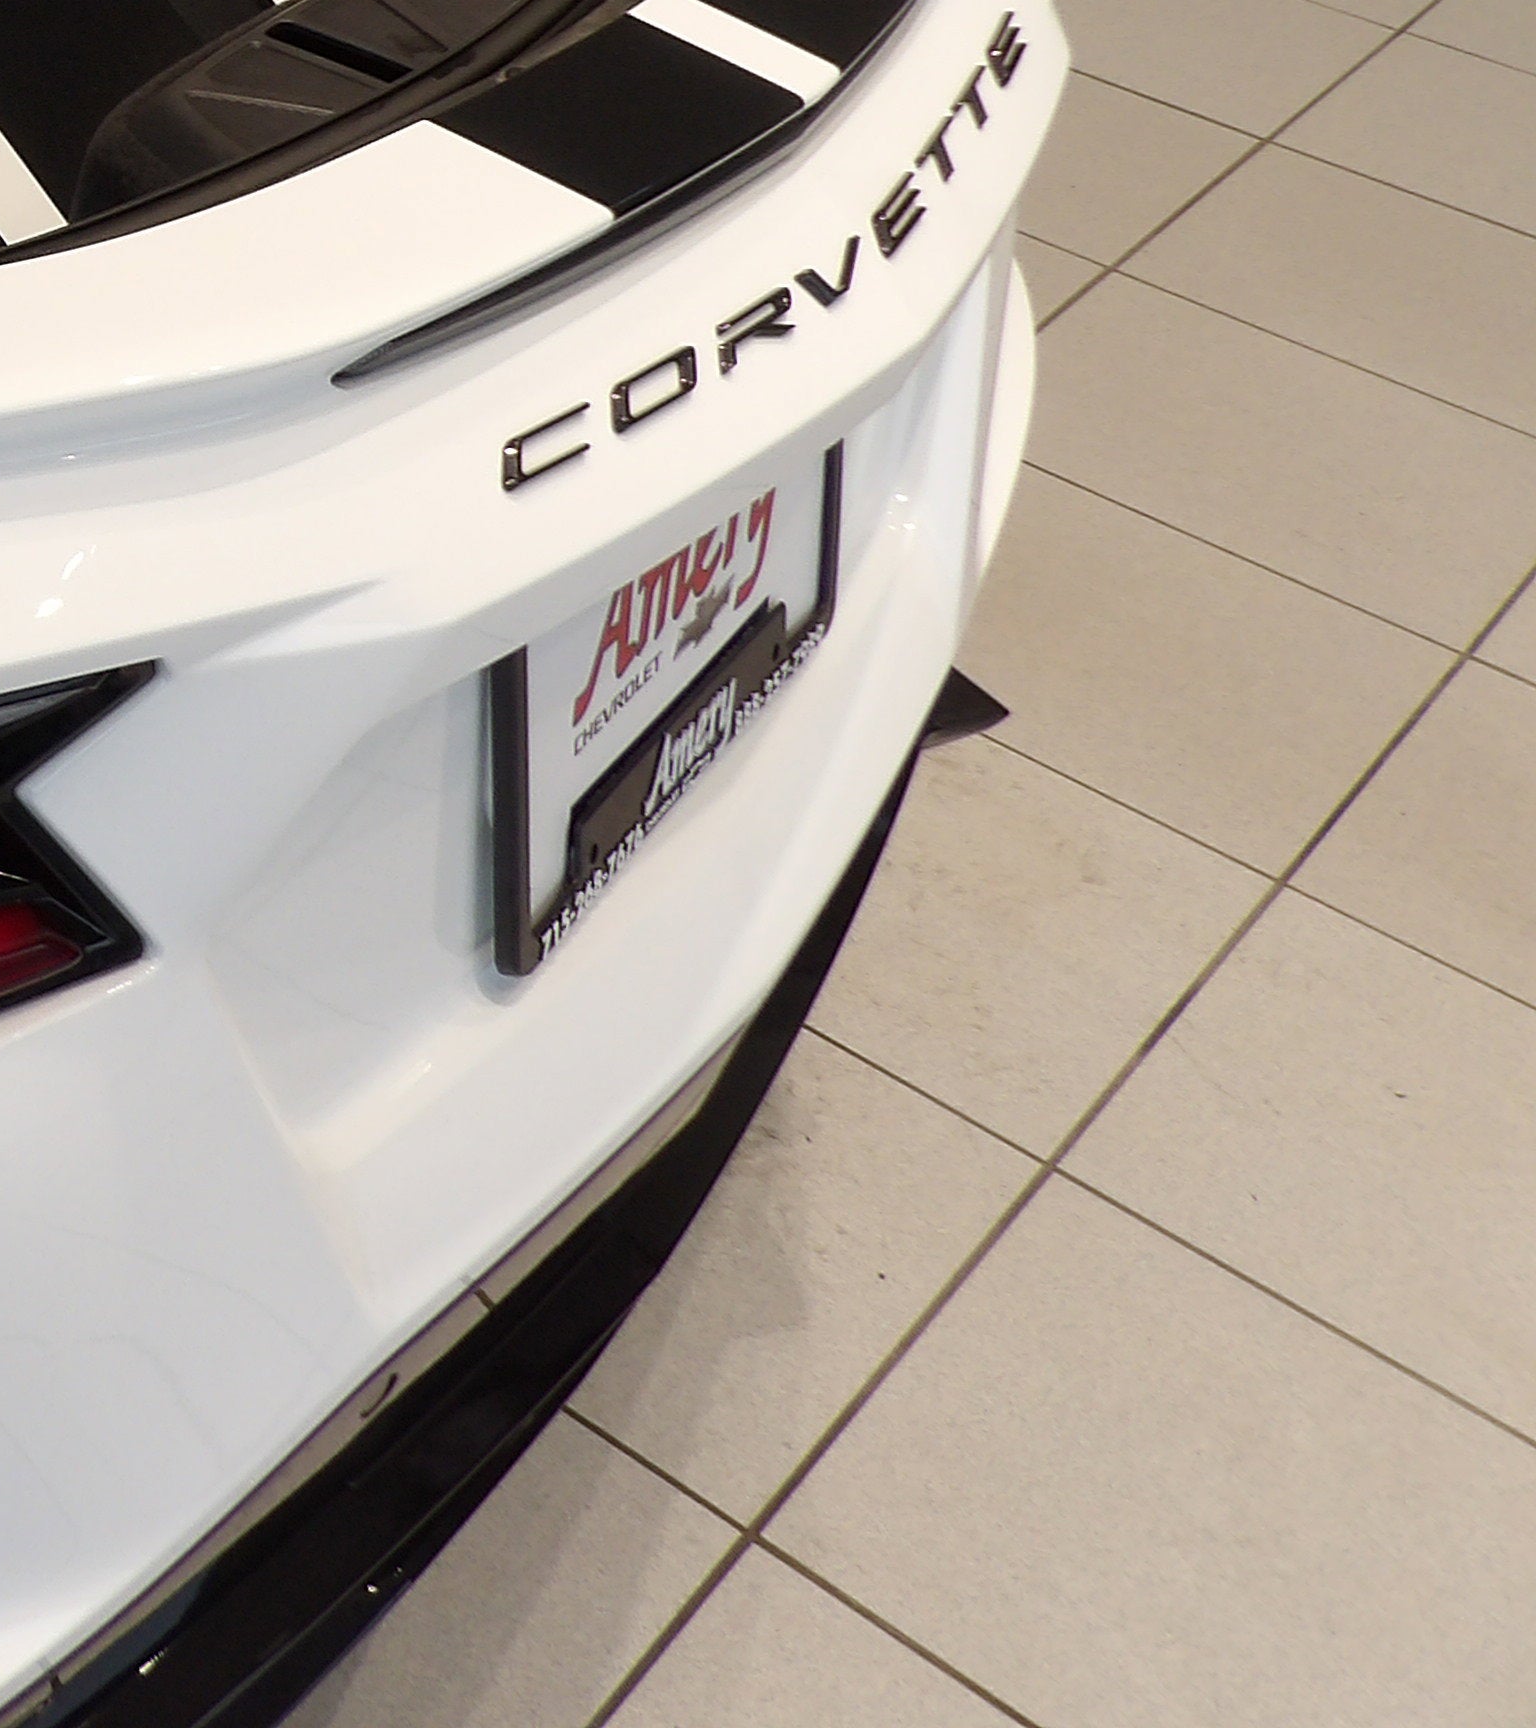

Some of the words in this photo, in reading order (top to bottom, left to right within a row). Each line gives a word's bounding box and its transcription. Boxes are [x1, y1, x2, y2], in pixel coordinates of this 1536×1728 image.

[501, 10, 1027, 492] CORVETTE
[572, 486, 777, 728] Amery
[573, 650, 663, 757] CHEVROLET
